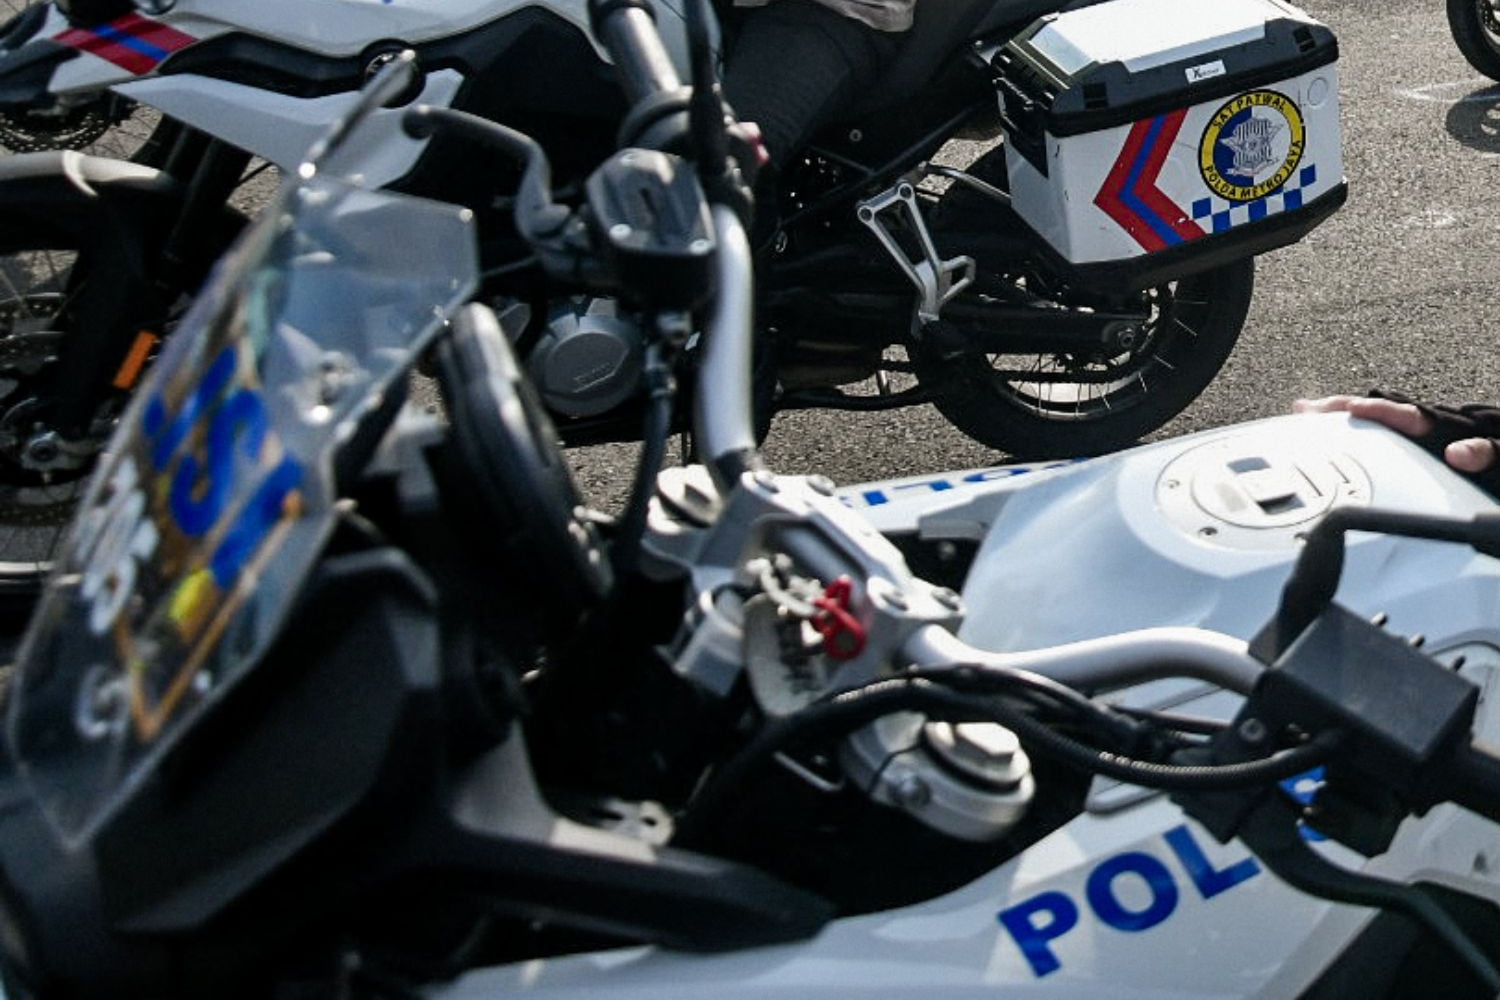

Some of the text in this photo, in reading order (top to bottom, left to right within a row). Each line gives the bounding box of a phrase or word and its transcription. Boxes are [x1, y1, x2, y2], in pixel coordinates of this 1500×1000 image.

[1213, 92, 1288, 129] SAT PATWAL
[1204, 140, 1301, 200] POLDA METRO JAYA
